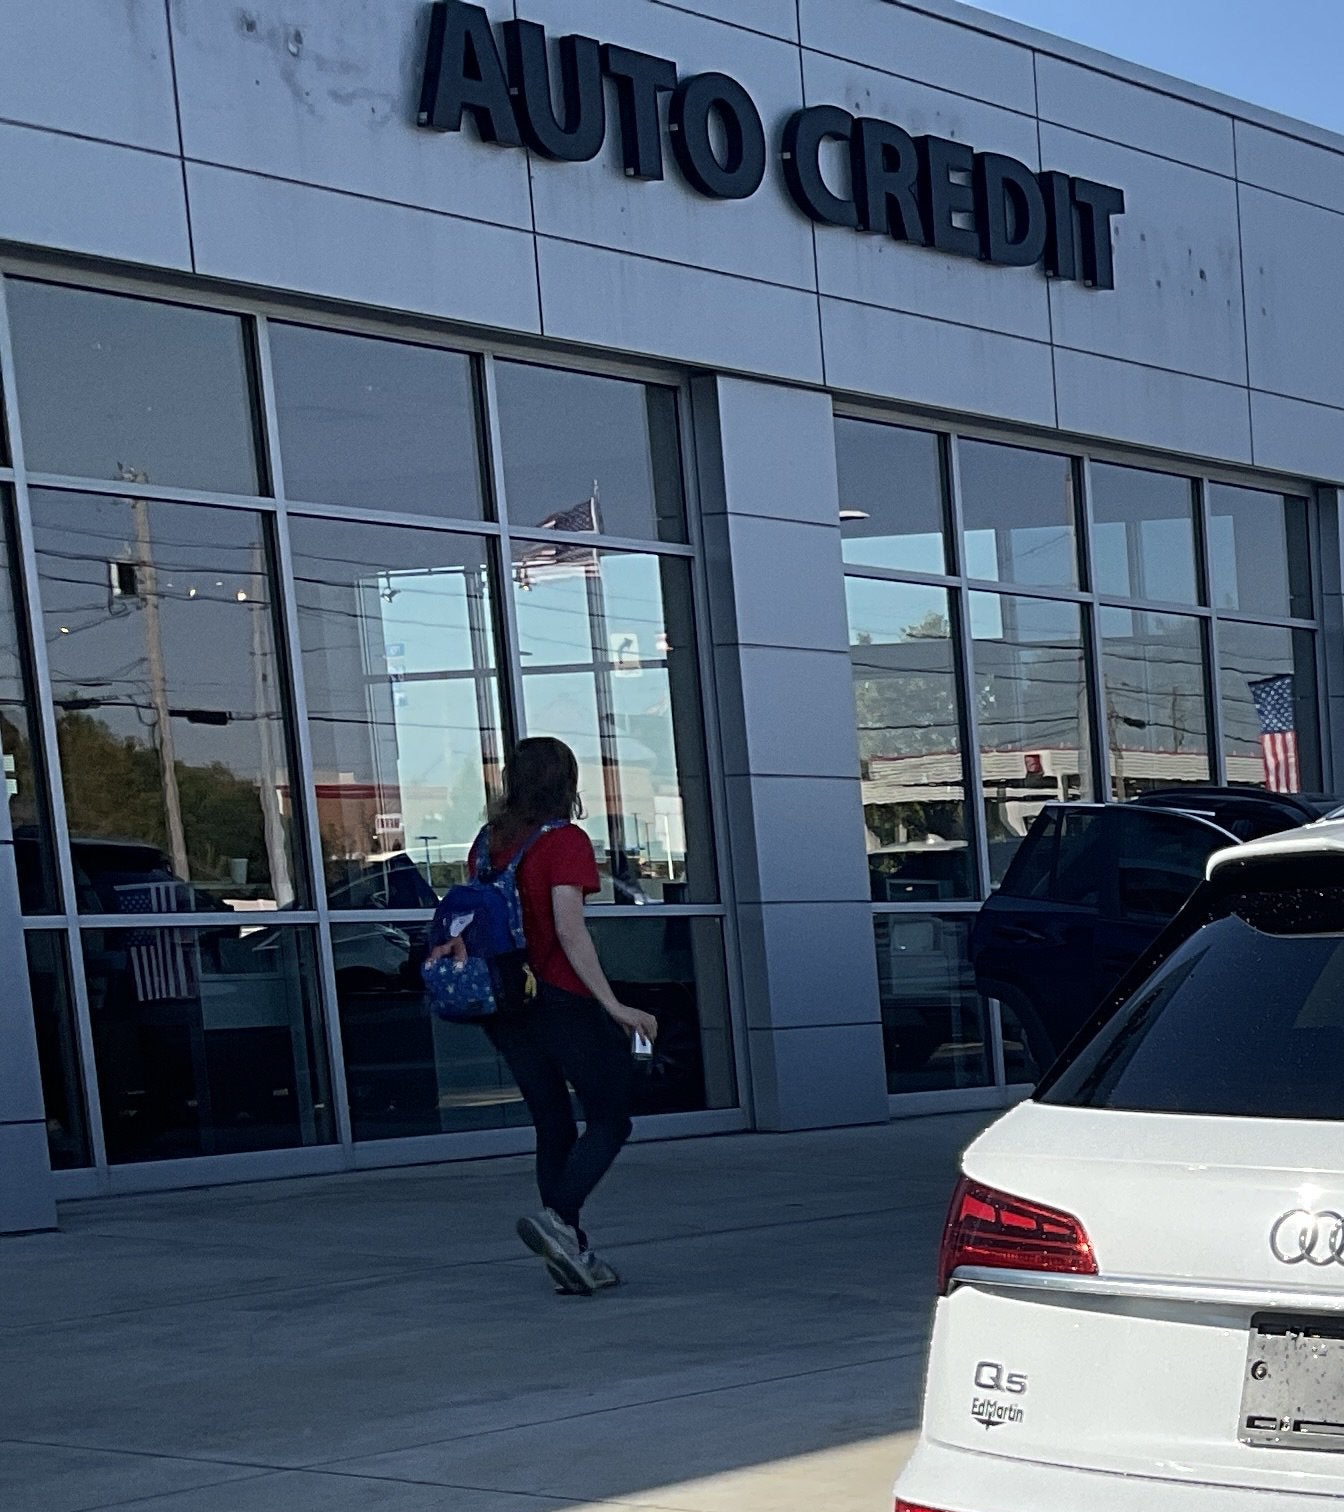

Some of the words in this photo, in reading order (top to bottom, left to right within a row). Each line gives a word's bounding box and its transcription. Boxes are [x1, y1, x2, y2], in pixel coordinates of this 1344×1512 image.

[417, 0, 767, 200] AUTO
[780, 104, 1125, 291] CREDIT
[974, 1361, 1028, 1395] Q5
